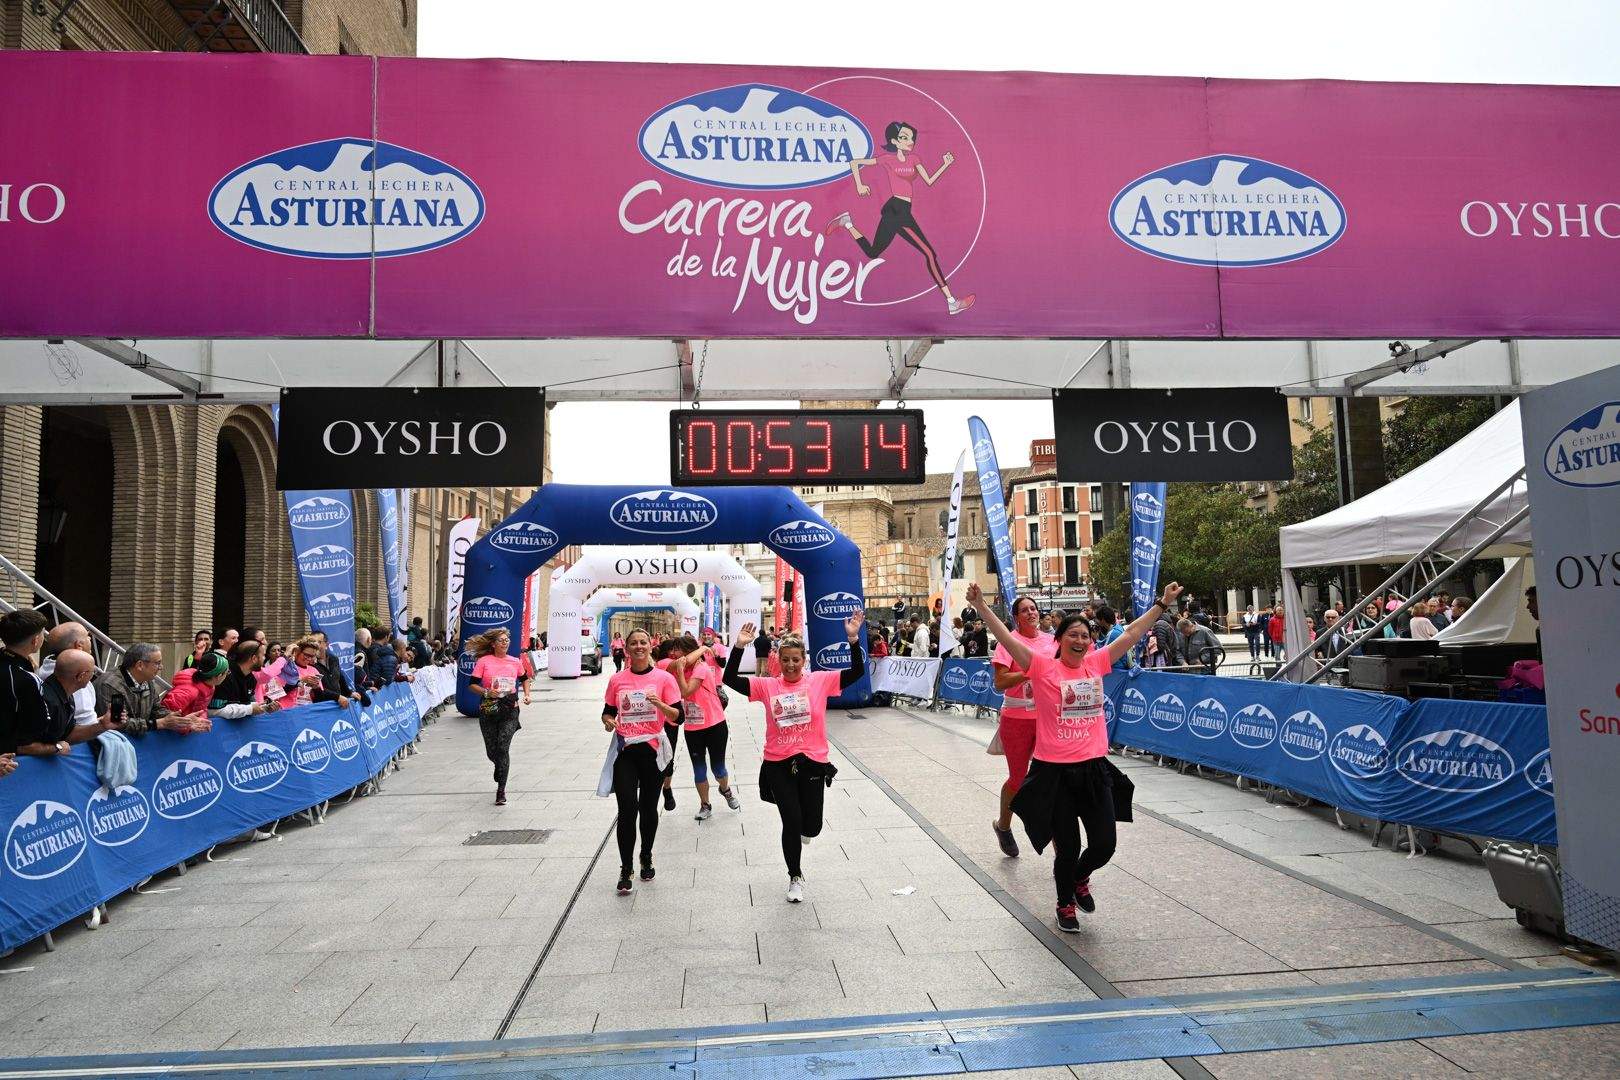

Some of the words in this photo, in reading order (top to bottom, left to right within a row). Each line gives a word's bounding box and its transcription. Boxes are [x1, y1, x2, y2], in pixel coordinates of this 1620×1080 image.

[694, 119, 767, 130] CENTRAL
[774, 120, 848, 132] LECHERA
[657, 120, 854, 163] ASTURIANA
[274, 180, 358, 192] CENTRAL
[369, 180, 455, 192] LECHERA
[229, 181, 465, 227] ASTURIANA
[618, 180, 813, 238] Carrera
[1164, 192, 1238, 204] CENTRAL
[1245, 194, 1320, 205] LECHERA
[1128, 195, 1330, 237] ASTURIANA
[666, 239, 703, 277] de
[711, 238, 738, 278] la
[731, 232, 887, 325] Mujer
[323, 420, 507, 456] OYSHO
[687, 420, 832, 474] 00:53
[862, 423, 907, 471] 14
[1093, 420, 1257, 454] OYSHO
[1572, 432, 1617, 447] CENTRAL
[1554, 442, 1620, 474] ASTUR
[618, 503, 710, 524] ASTURIANA
[1040, 493, 1048, 532] HOTEL
[493, 532, 553, 546] ASTURIANA
[774, 531, 832, 544] ASTURIANA
[615, 557, 698, 576] OYSHO
[720, 574, 746, 582] OYSHO
[464, 606, 510, 619] ASTURIANA
[888, 660, 927, 678] OYSHO
[1151, 706, 1183, 723] ASTURIANA
[1190, 711, 1224, 731] ASTURIANA
[777, 734, 804, 744] SUMA
[1232, 718, 1273, 740] ASTURIANA
[1281, 725, 1323, 751] ASTURIANA
[296, 746, 330, 766] ASTURIANA
[1401, 749, 1504, 780] ASTURIANA
[233, 758, 286, 786] ASTURIANA
[158, 778, 220, 812] ASTURIANA
[91, 804, 147, 837] ASTURIANA
[22, 825, 51, 842] CENTRAL
[13, 825, 85, 870] ASTURIANA
